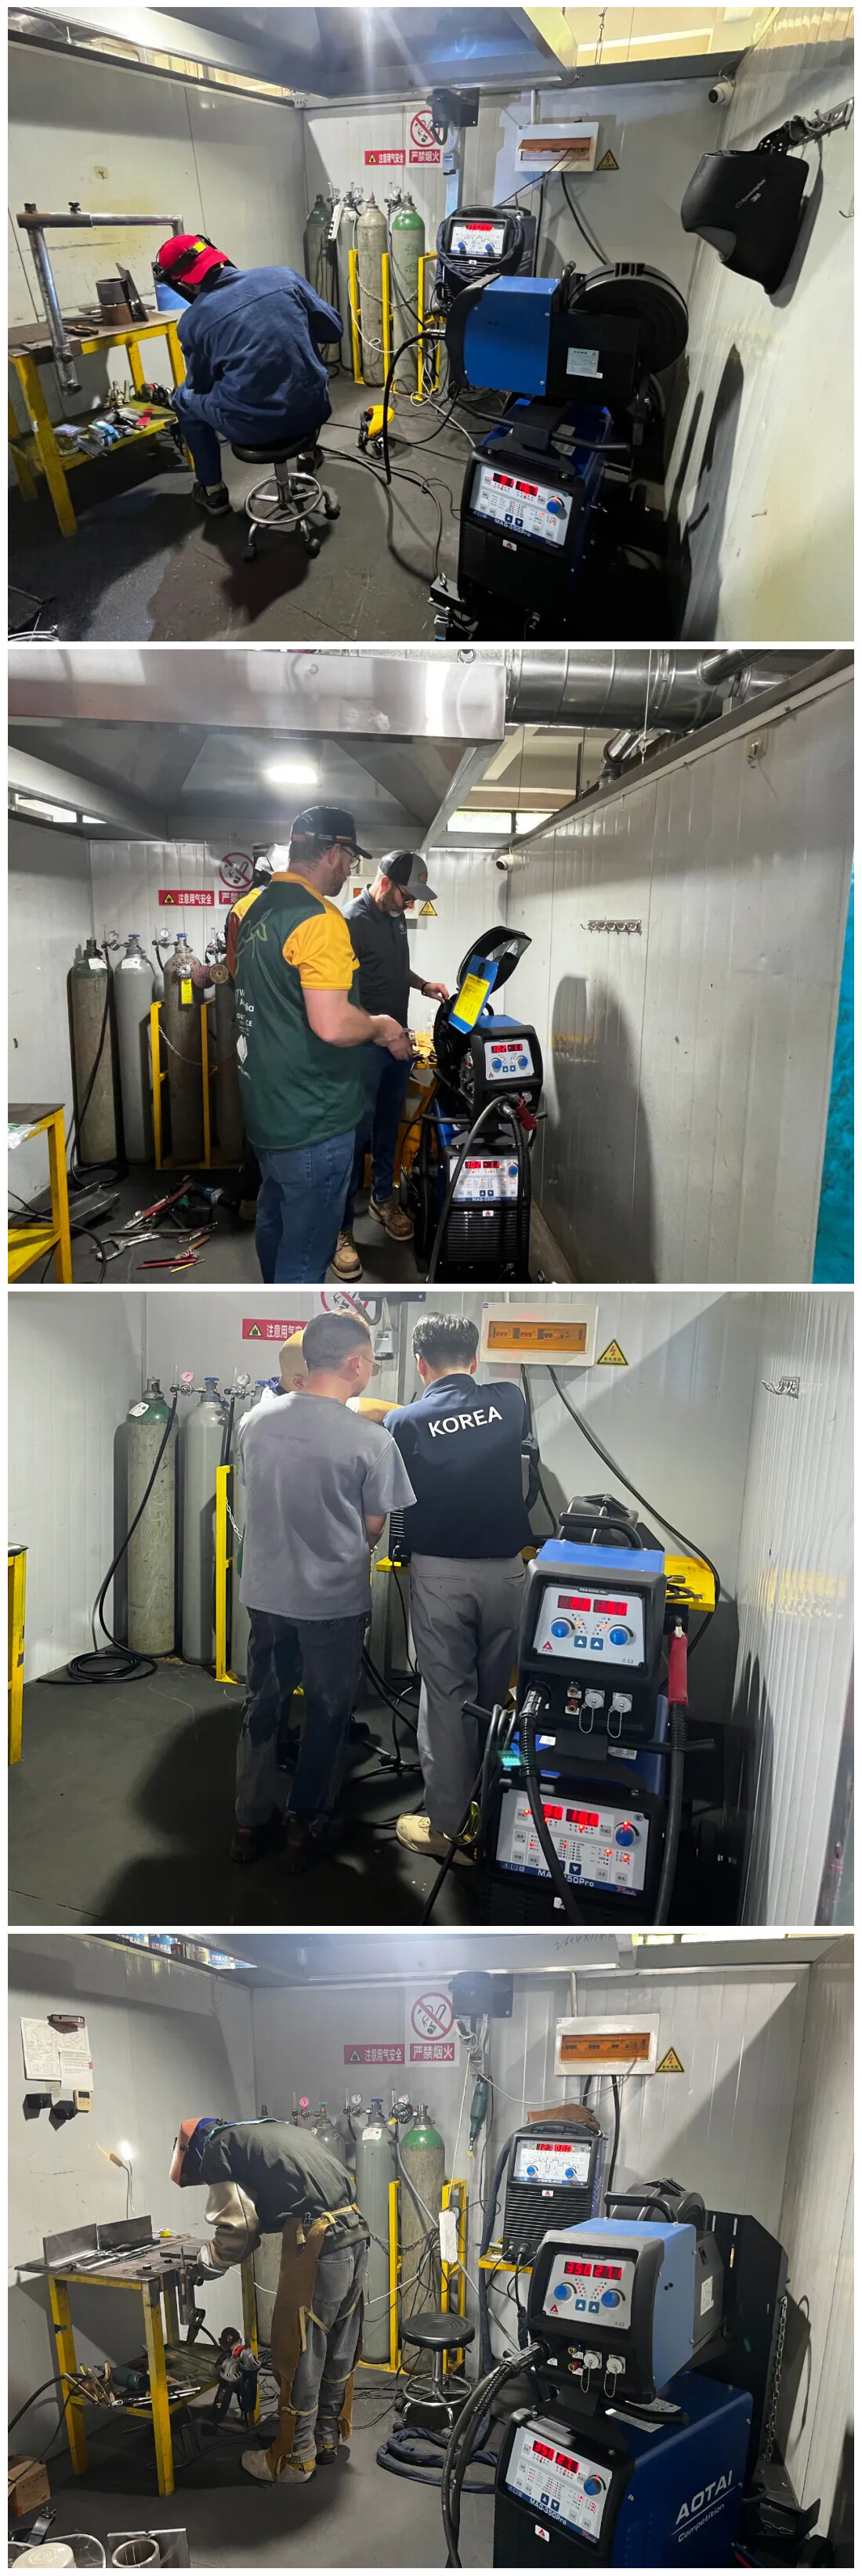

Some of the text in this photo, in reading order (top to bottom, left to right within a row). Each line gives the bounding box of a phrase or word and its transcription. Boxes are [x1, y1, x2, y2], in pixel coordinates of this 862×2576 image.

[378, 153, 404, 164] 注意用气安全
[411, 151, 440, 162] 严禁烟火
[178, 894, 212, 905] 注意用气安全
[266, 1324, 302, 1339] 注意用气
[428, 1406, 503, 1438] KOREA
[538, 1869, 595, 1888] MA50Pro
[364, 2048, 402, 2062] 注意用气安全
[413, 2045, 453, 2060] 严禁烟火
[566, 2261, 592, 2277] 350
[675, 2469, 733, 2525] AOTAI
[529, 2498, 567, 2526] MAG-350Pro
[678, 2503, 725, 2543] Competition
